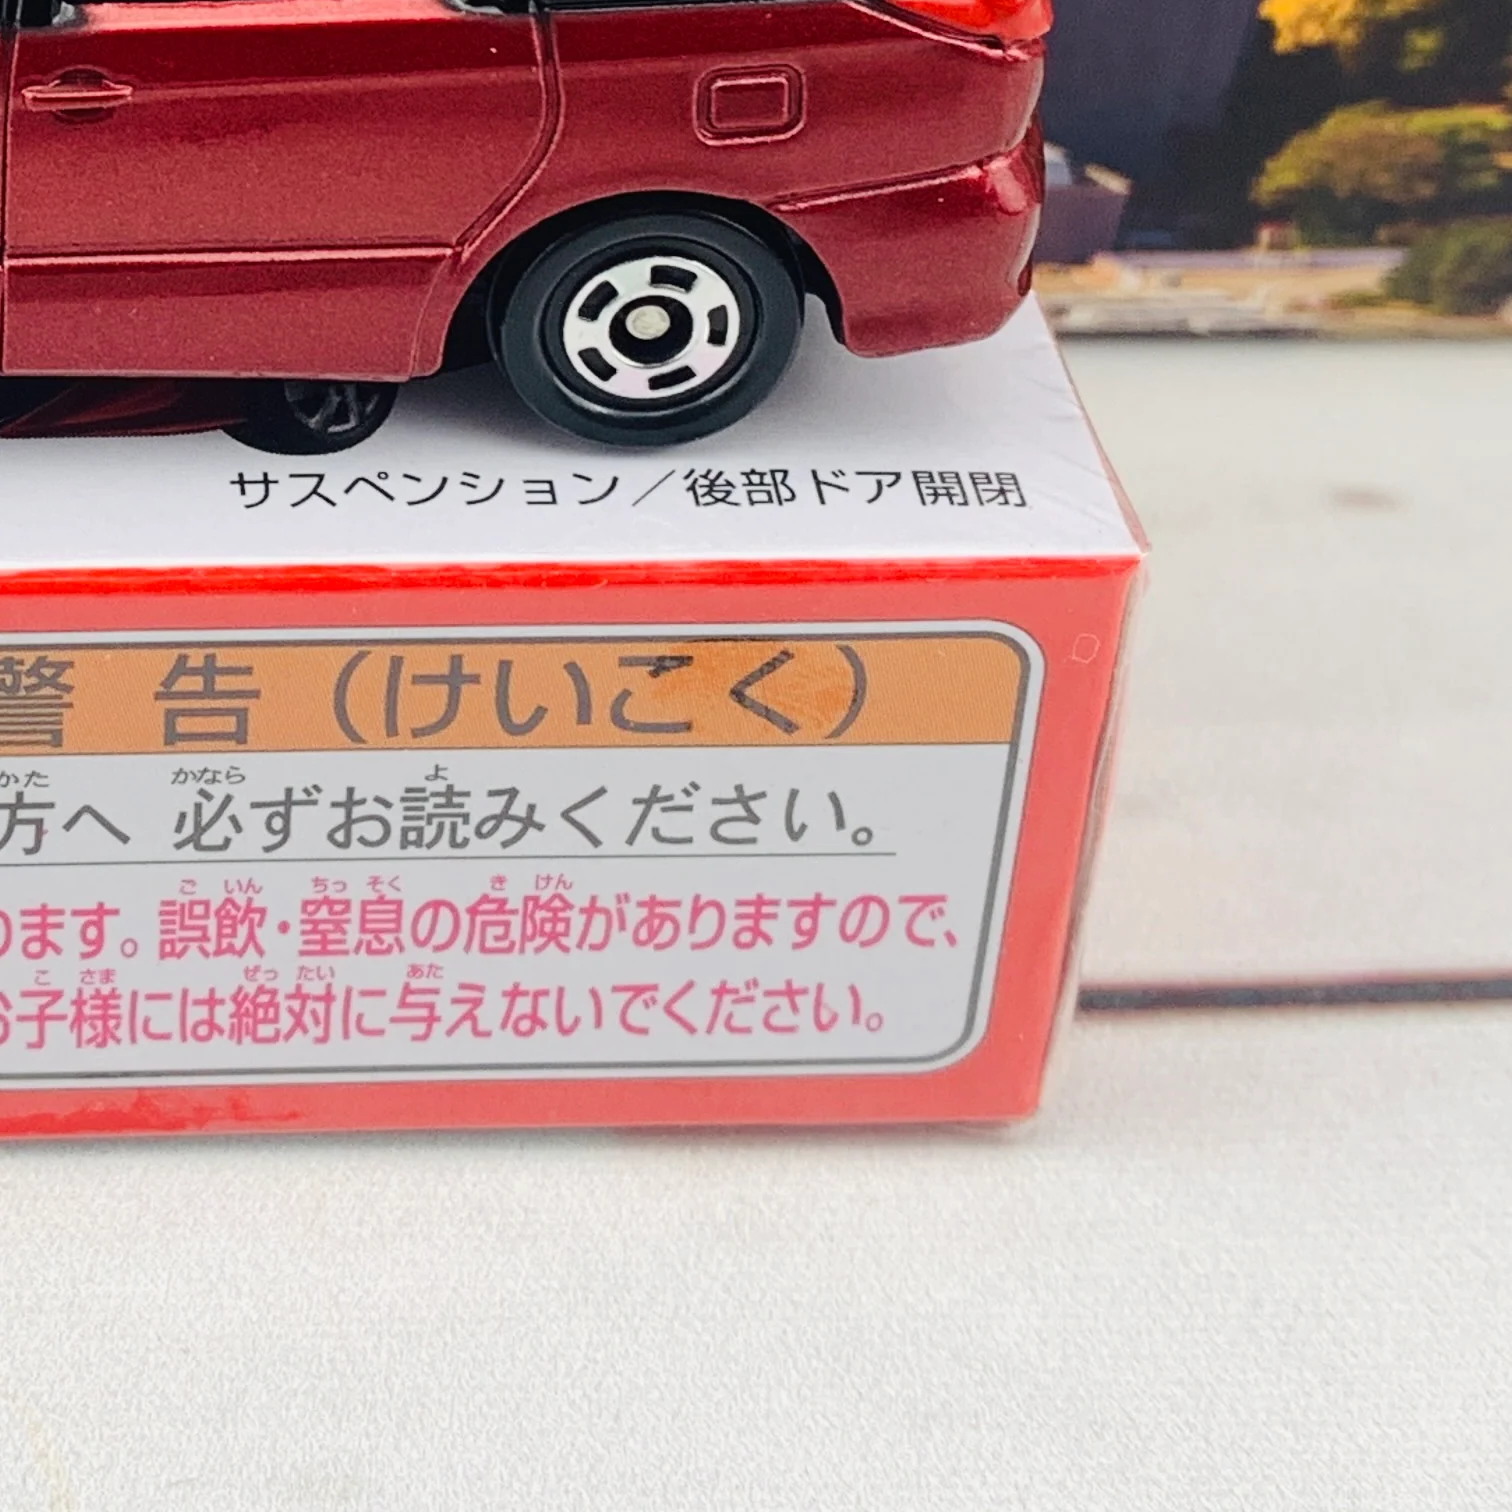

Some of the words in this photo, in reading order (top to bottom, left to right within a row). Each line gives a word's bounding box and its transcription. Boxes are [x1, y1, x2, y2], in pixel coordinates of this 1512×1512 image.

[171, 766, 246, 785] かなら
[424, 764, 449, 782] よ
